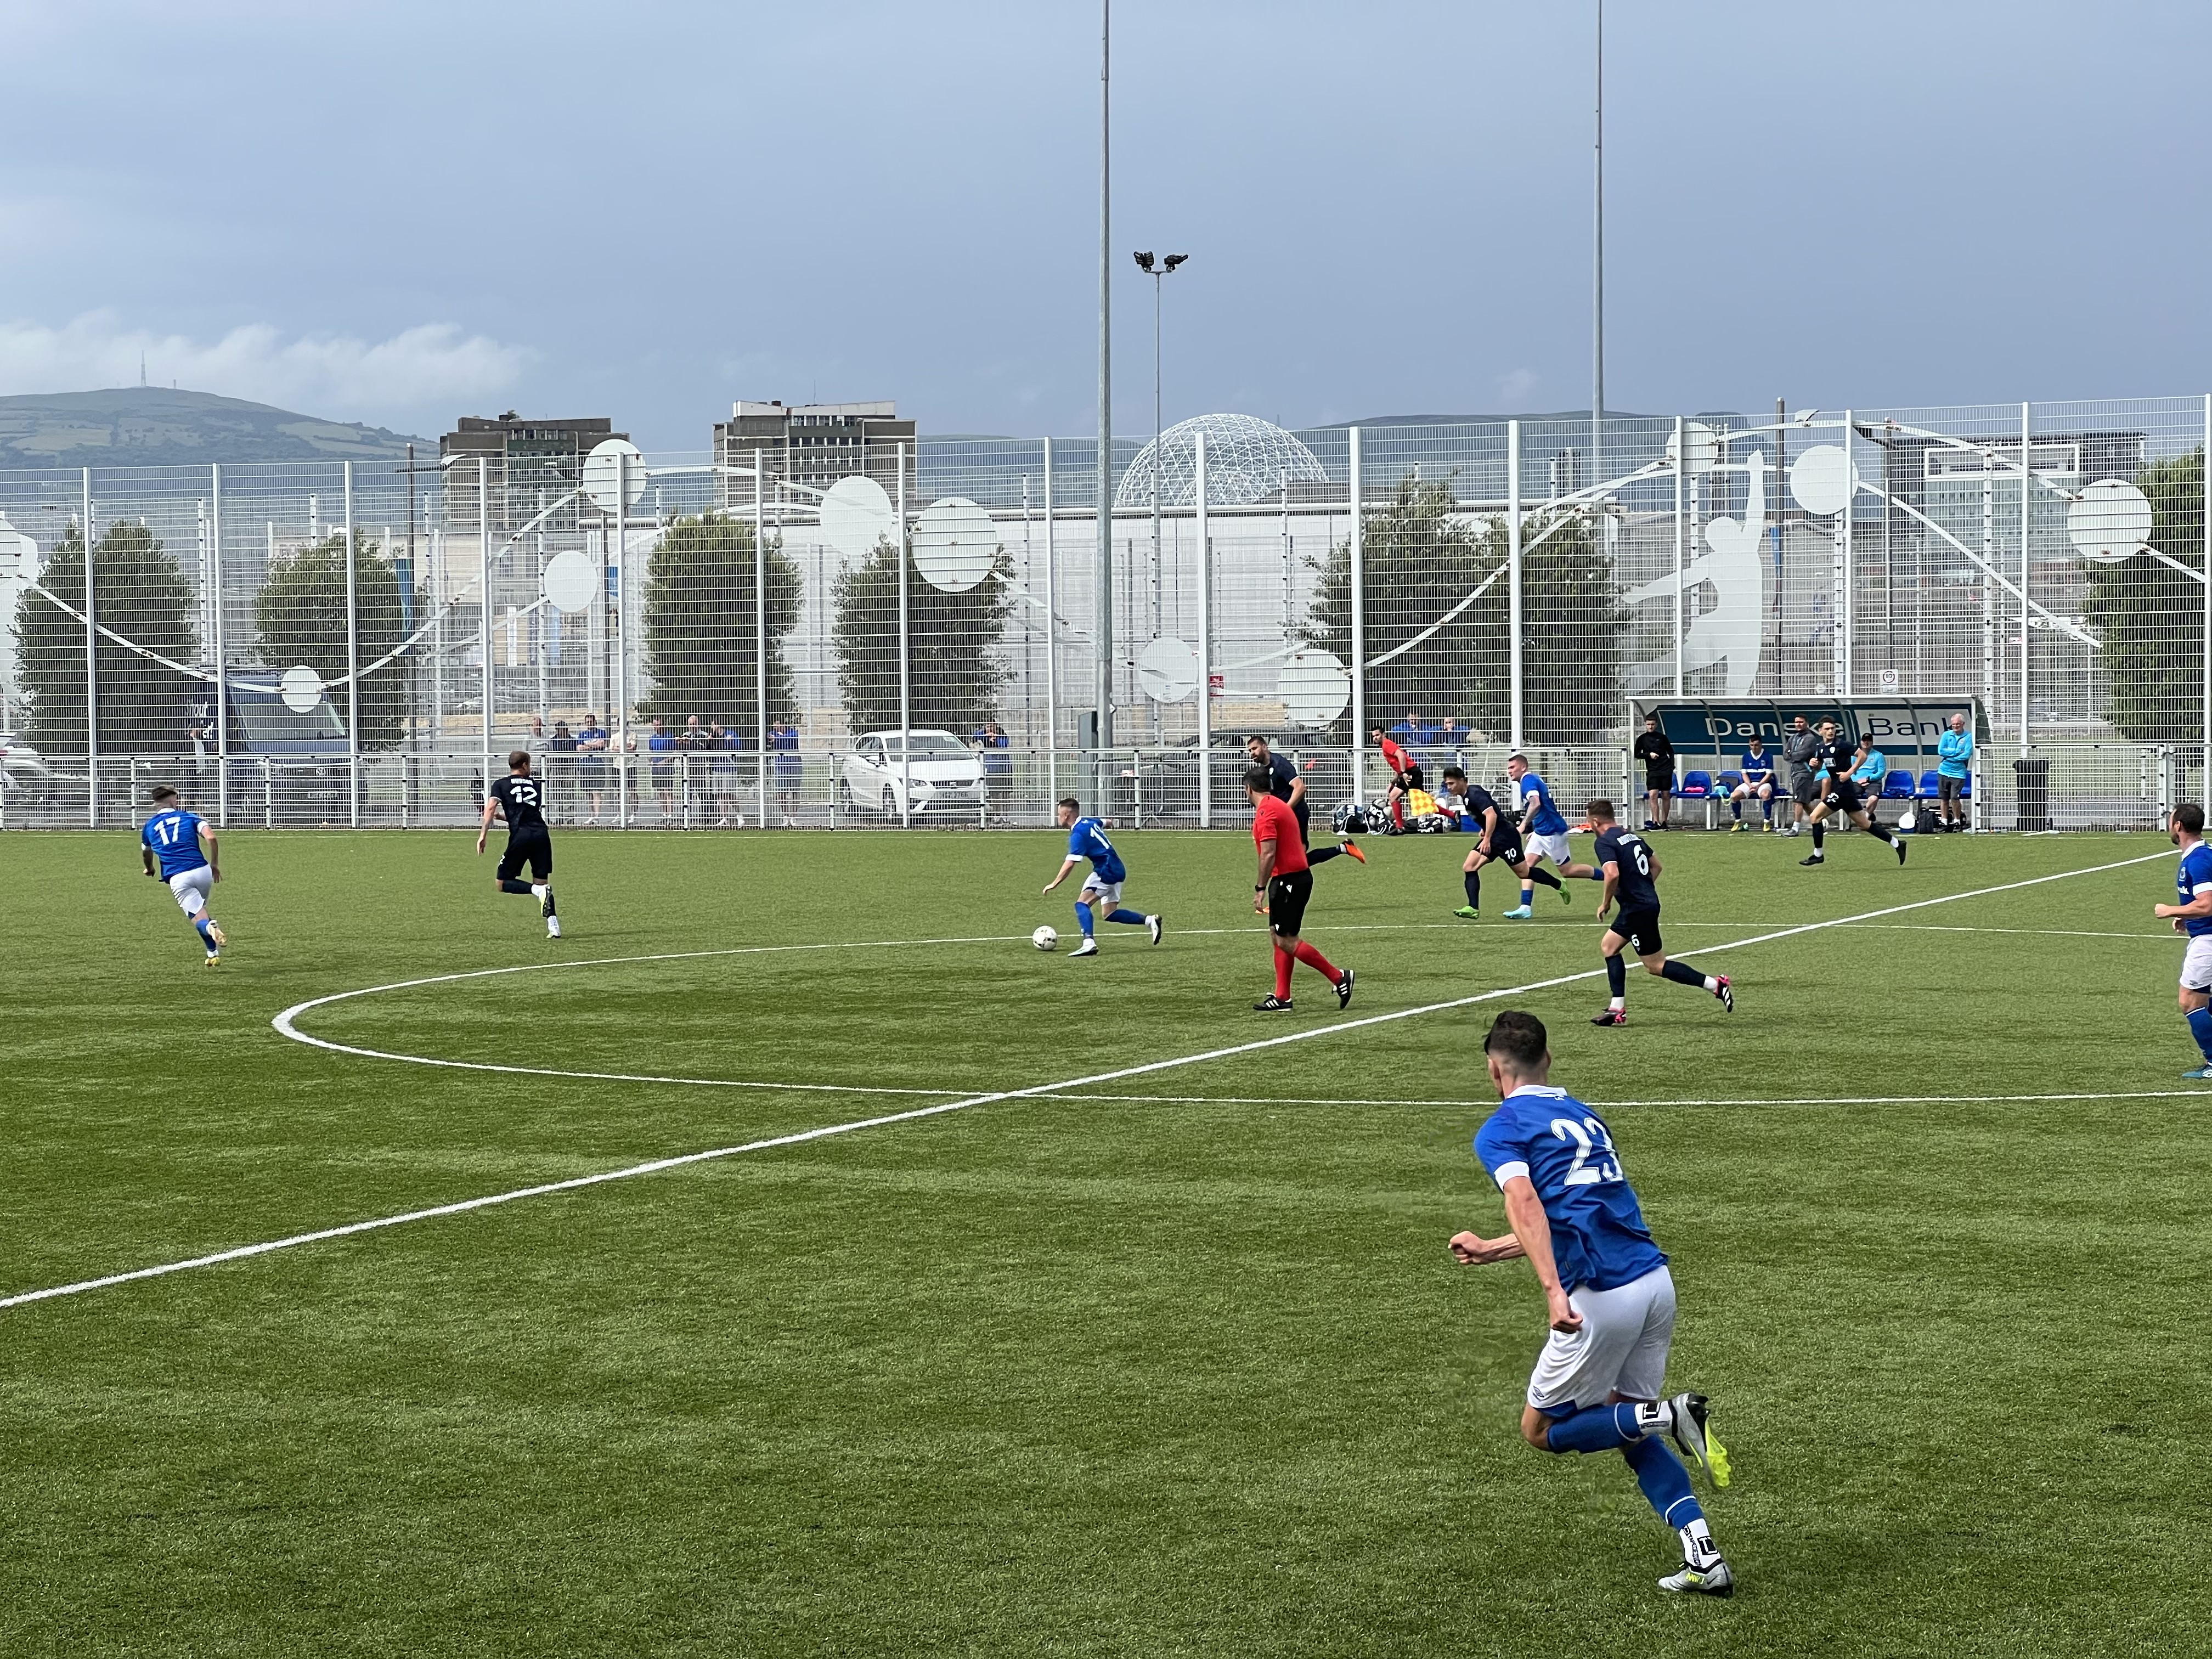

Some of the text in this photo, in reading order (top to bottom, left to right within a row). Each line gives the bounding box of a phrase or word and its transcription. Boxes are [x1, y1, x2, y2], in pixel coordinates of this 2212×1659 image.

[510, 786, 538, 807] 12
[154, 816, 180, 846] 17
[1504, 848, 1517, 860] 10
[1633, 844, 1649, 876] 6
[1631, 934, 1640, 946] 6
[1550, 1117, 1624, 1186] 23
